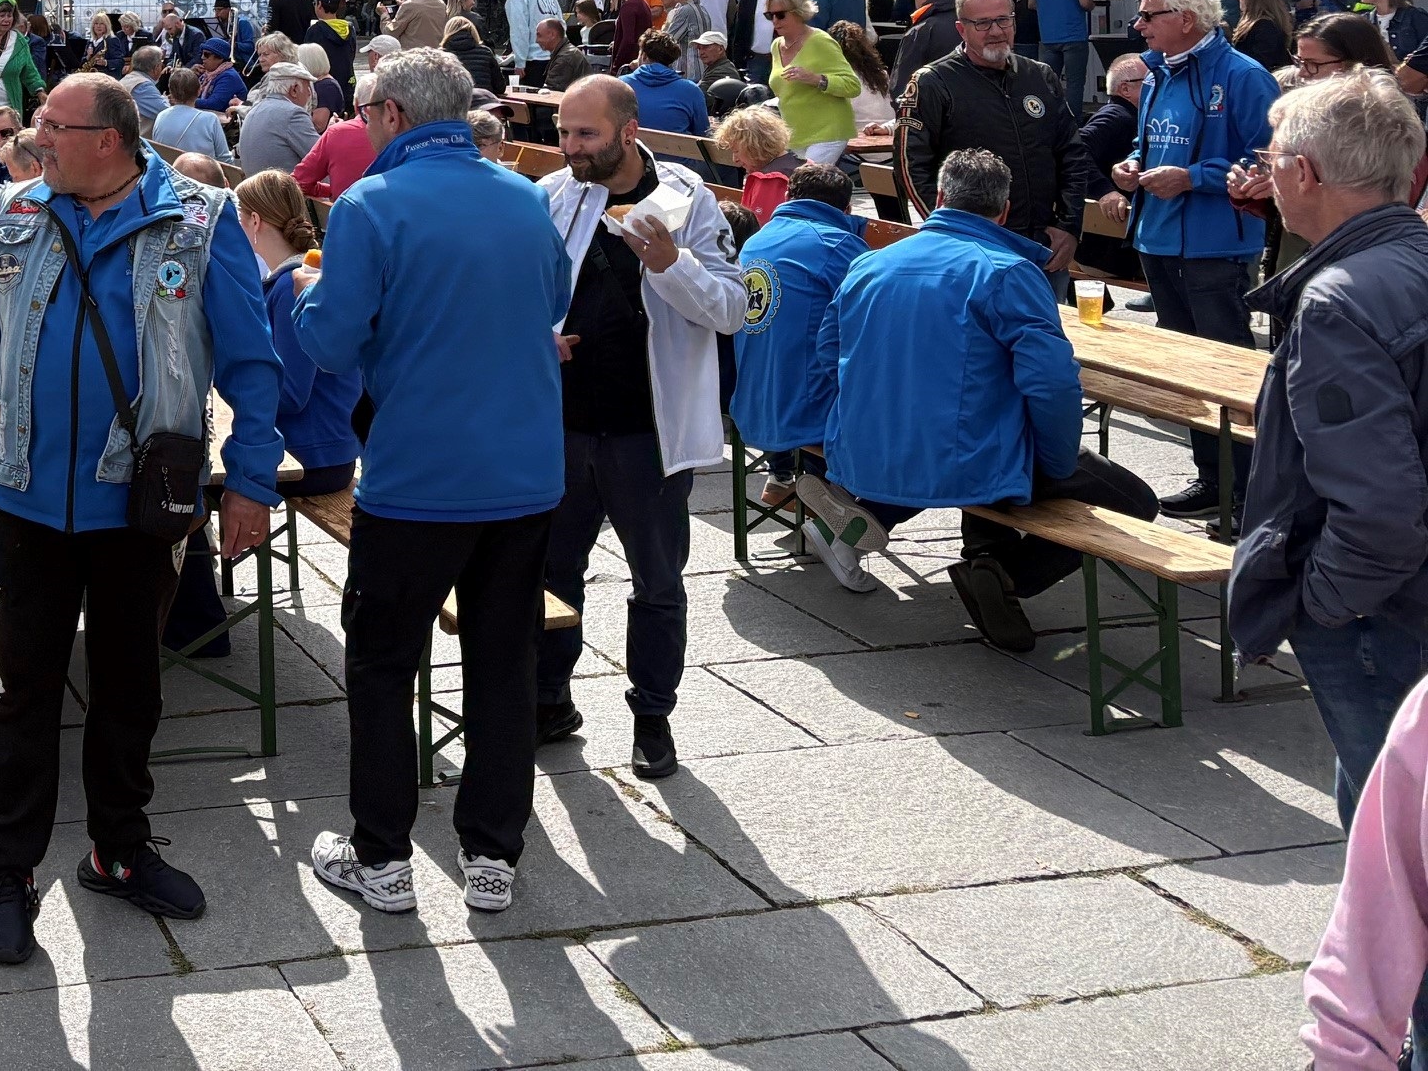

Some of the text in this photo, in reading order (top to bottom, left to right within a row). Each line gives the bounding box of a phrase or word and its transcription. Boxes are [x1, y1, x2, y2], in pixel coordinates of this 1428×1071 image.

[431, 136, 450, 145] Vespa
[450, 134, 465, 144] Club
[168, 502, 183, 514] CAMP
